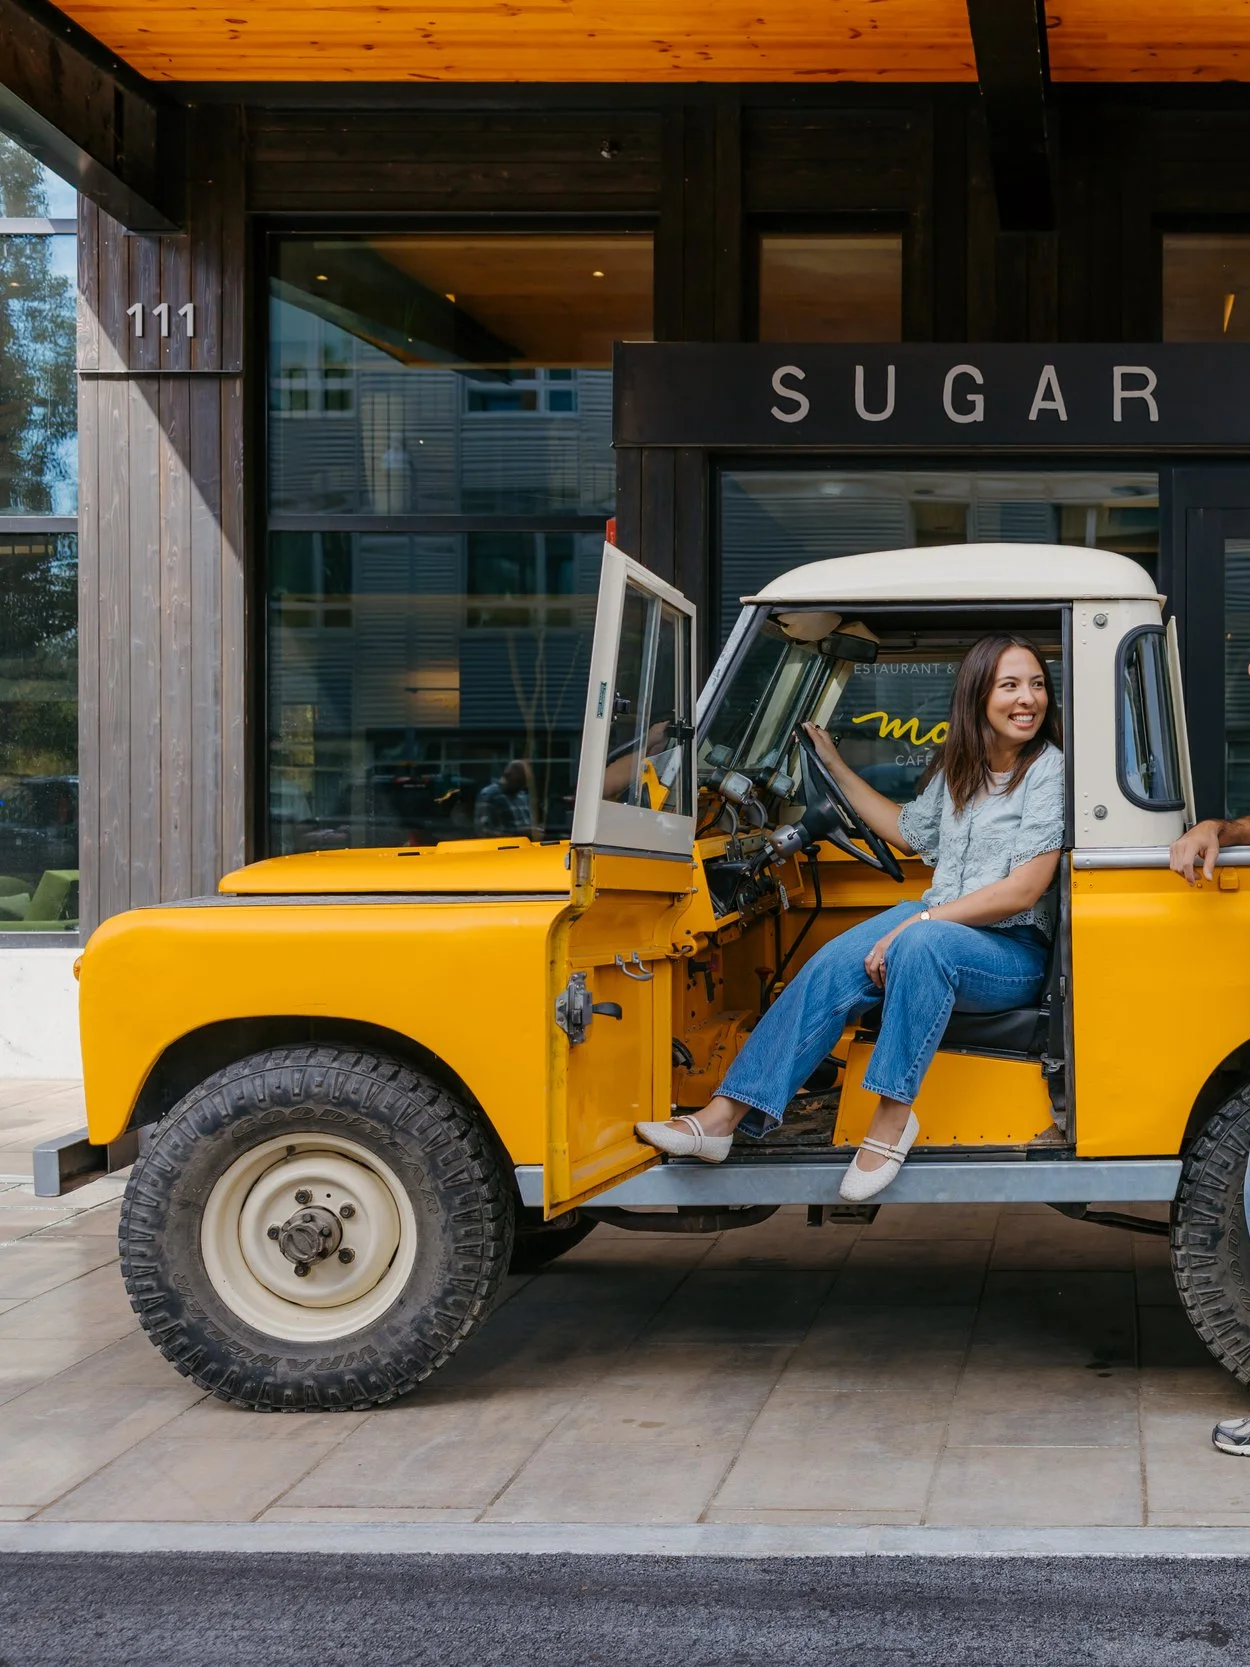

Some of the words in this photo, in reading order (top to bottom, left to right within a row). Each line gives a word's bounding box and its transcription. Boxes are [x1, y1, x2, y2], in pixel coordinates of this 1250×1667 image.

[126, 303, 194, 337] 111
[771, 364, 1159, 423] SUGAR
[853, 663, 940, 674] ESTAURANT
[946, 663, 956, 674] &
[232, 1106, 441, 1214] GOODYEAR
[172, 1271, 379, 1372] WRANGLER
